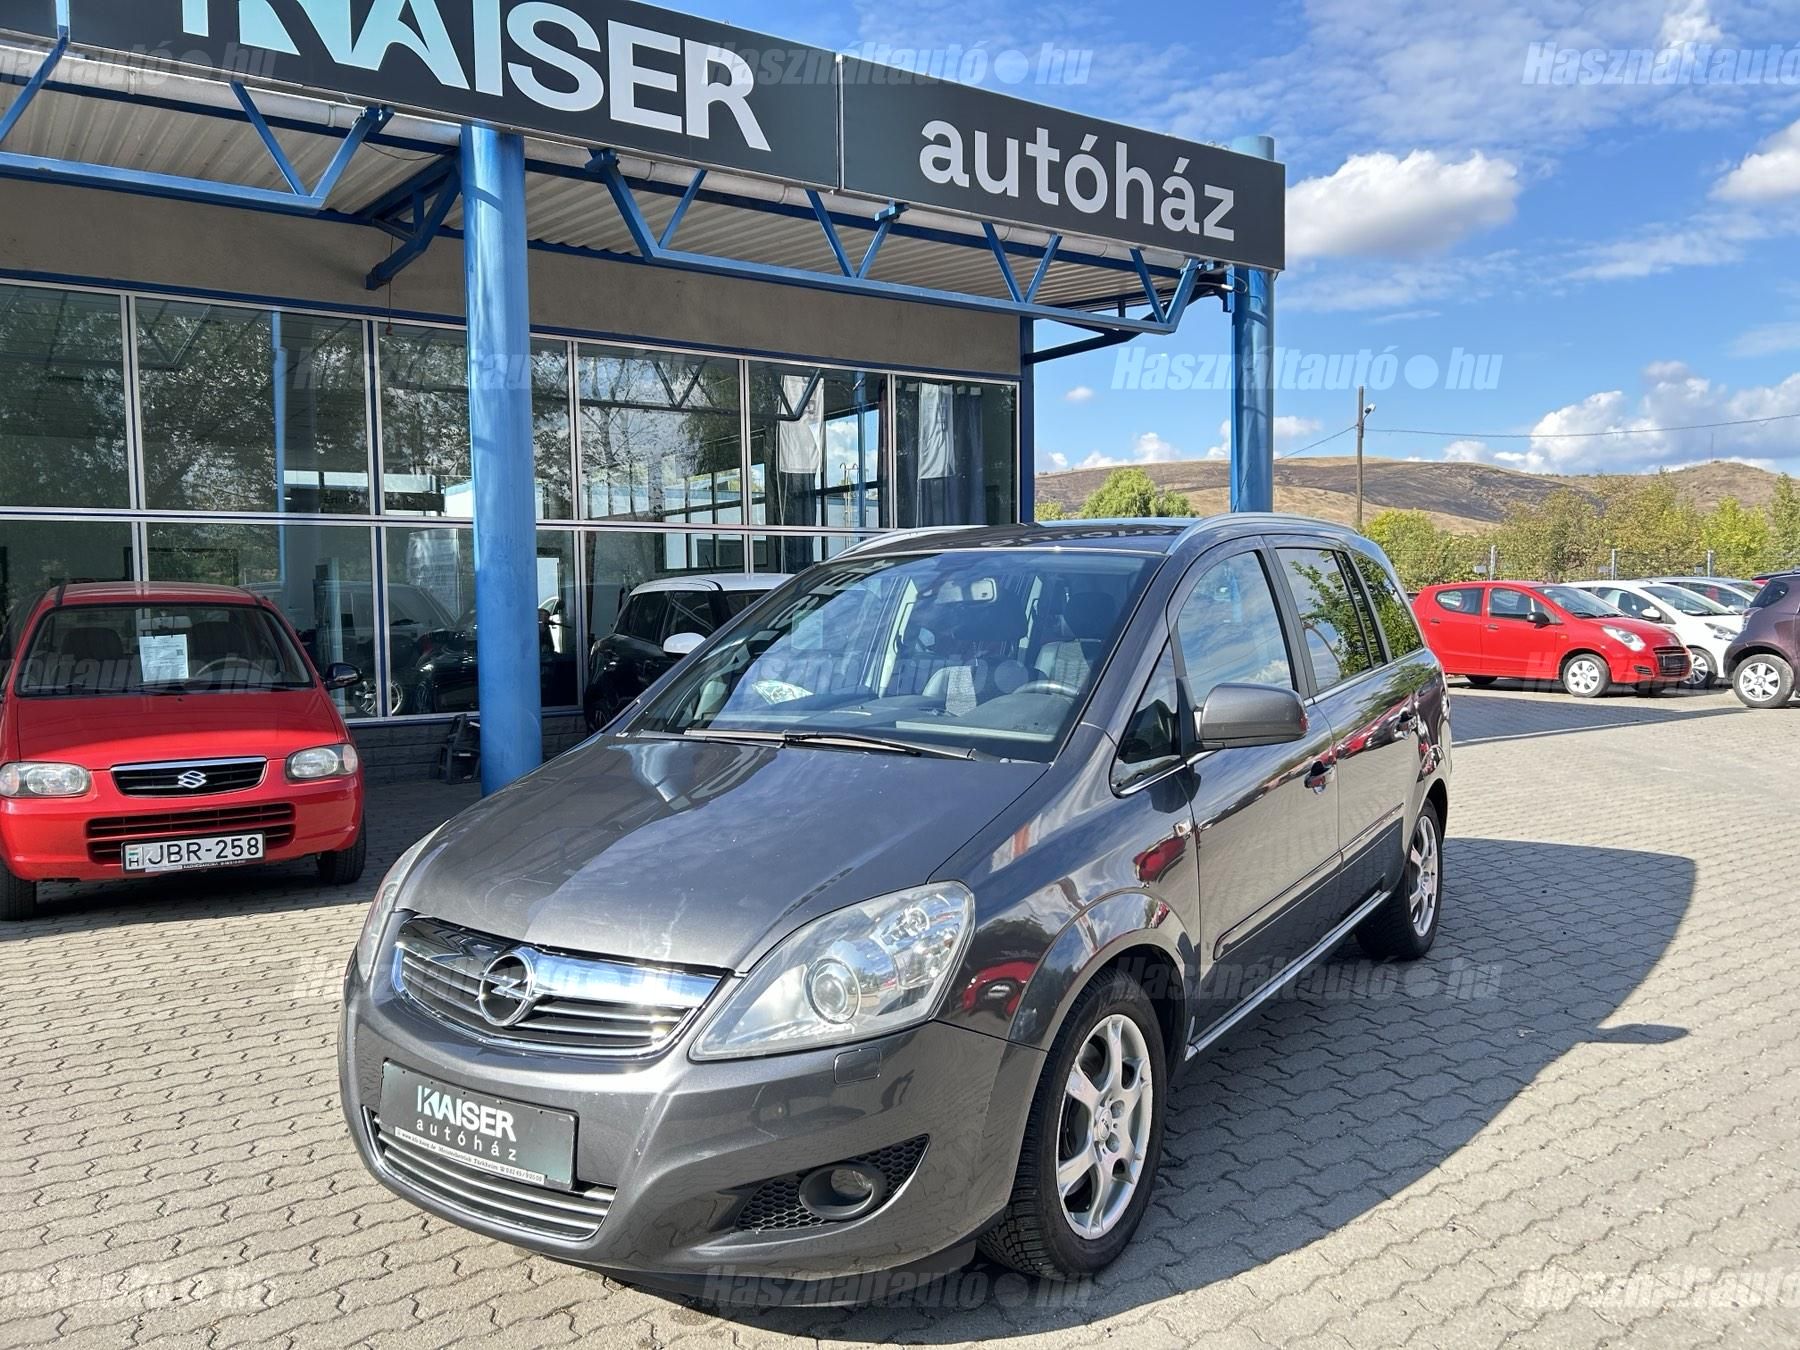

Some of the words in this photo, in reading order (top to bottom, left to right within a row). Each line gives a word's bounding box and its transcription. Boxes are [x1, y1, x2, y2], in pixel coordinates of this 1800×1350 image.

[919, 119, 1235, 242] autóház
[148, 836, 259, 865] JBR-258
[416, 1085, 517, 1142] KAISER
[416, 1118, 517, 1161] autóház
